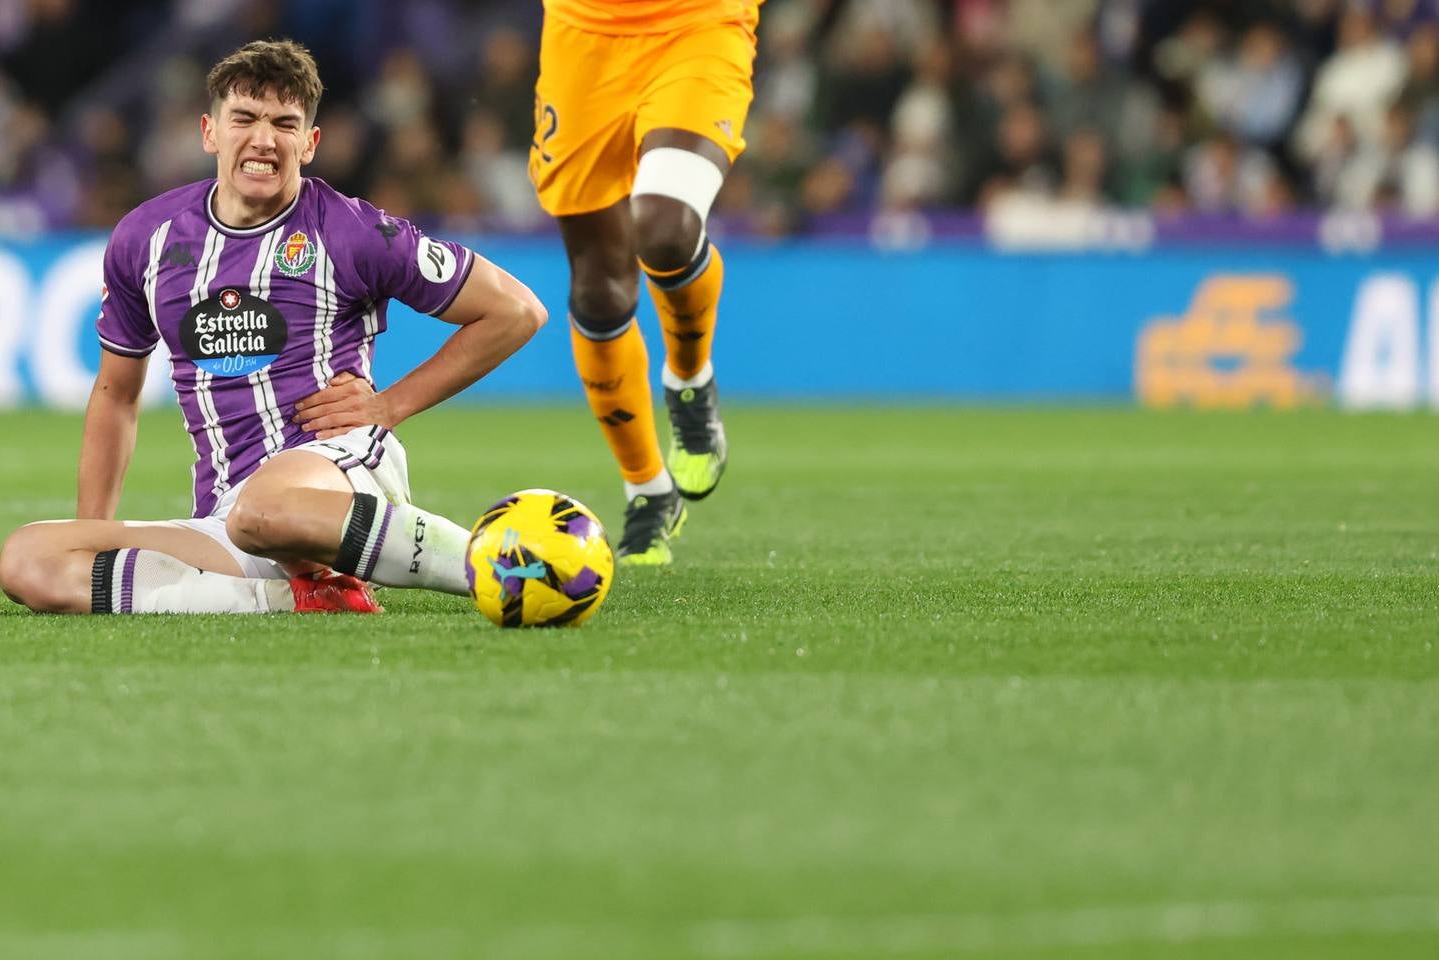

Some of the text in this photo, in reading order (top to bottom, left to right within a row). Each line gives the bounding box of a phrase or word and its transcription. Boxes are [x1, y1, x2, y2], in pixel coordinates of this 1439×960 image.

[195, 310, 269, 333] Estrella
[199, 331, 266, 355] Galicia
[223, 353, 244, 373] 0,0
[408, 516, 427, 575] RVCF
